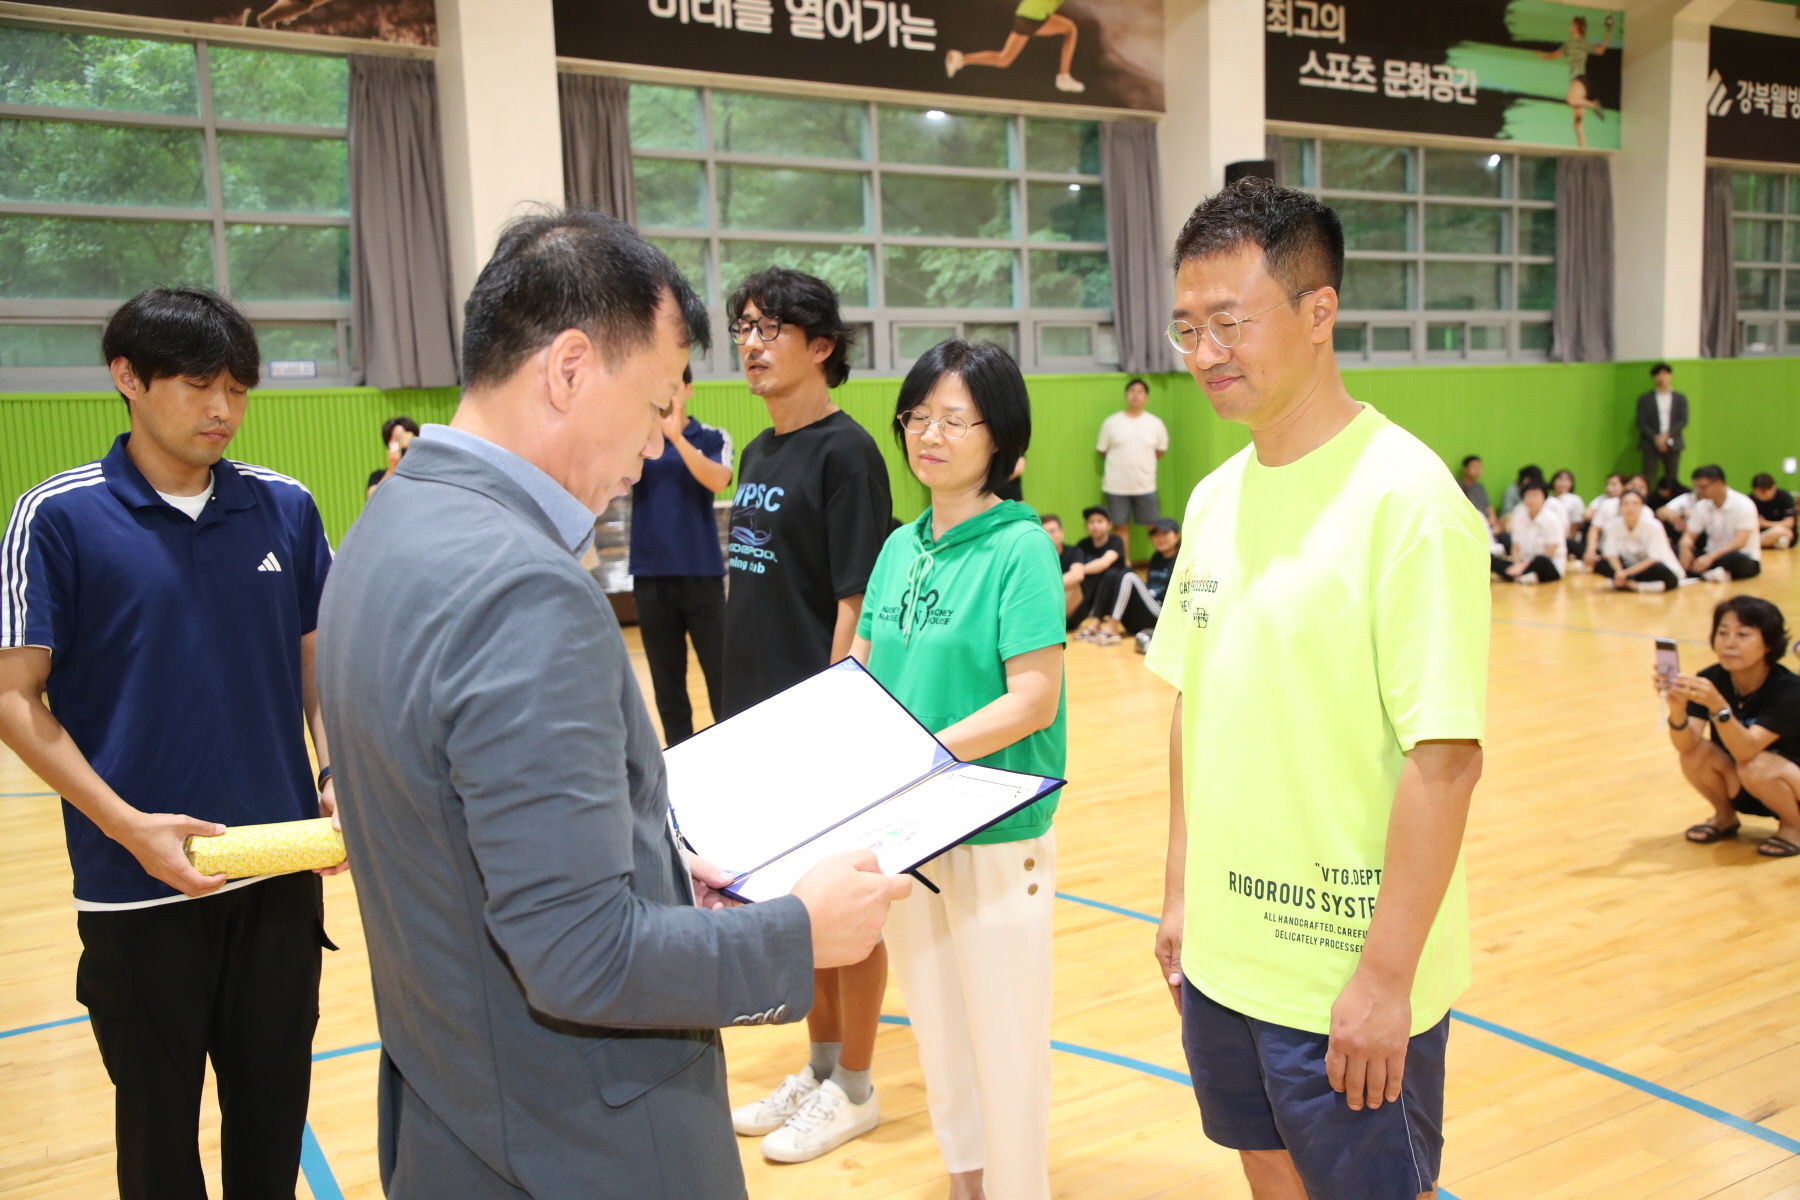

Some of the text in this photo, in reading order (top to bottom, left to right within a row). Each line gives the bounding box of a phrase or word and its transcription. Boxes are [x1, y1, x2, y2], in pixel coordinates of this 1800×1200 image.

[785, 0, 937, 51] 열어가는
[1266, 0, 1346, 44] 최고의
[1299, 50, 1478, 105] 스포츠 문화공간
[1229, 870, 1376, 919] RIGOROUS SYSTE
[1263, 911, 1276, 923] ALL
[1337, 926, 1368, 939] CAREFU
[1275, 929, 1318, 946] DELICATELY
